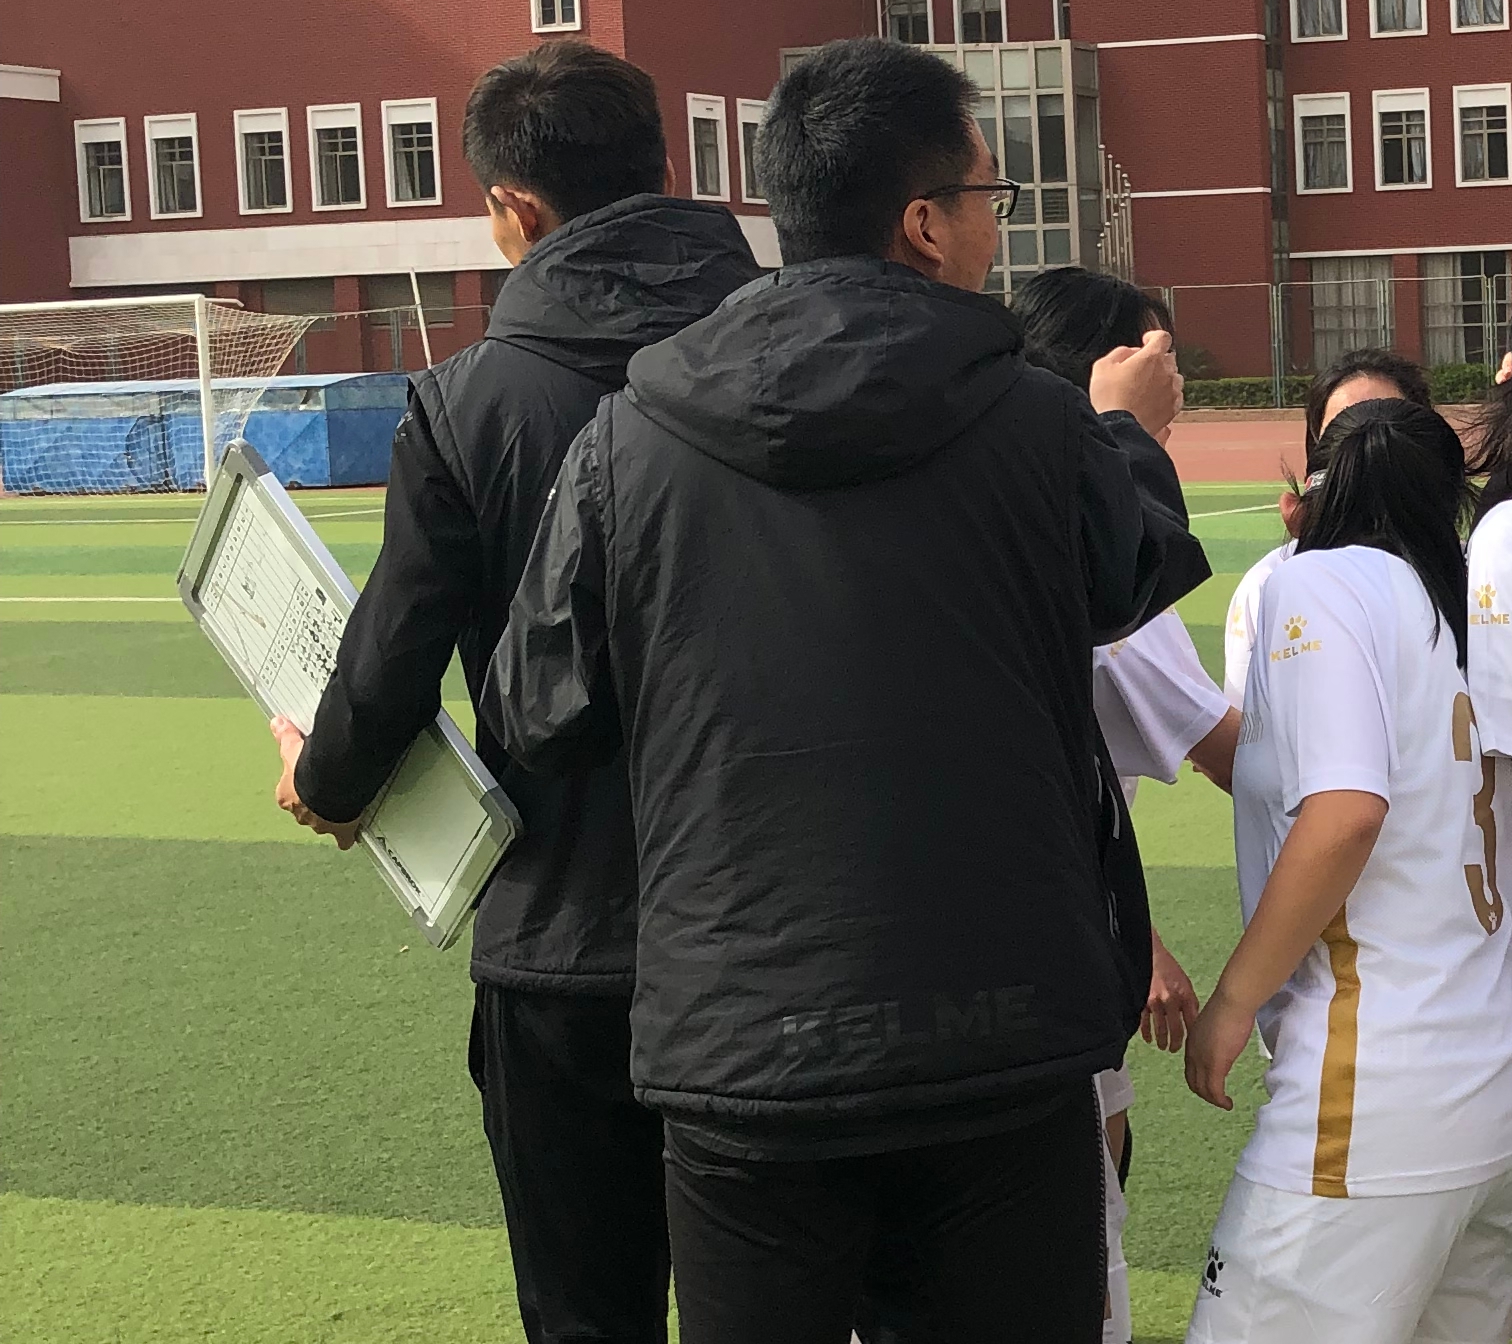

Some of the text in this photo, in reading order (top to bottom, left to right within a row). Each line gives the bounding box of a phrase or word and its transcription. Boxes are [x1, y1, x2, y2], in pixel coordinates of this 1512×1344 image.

[1270, 639, 1323, 662] KELME
[1452, 690, 1504, 937] 3
[782, 984, 1040, 1057] KELME
